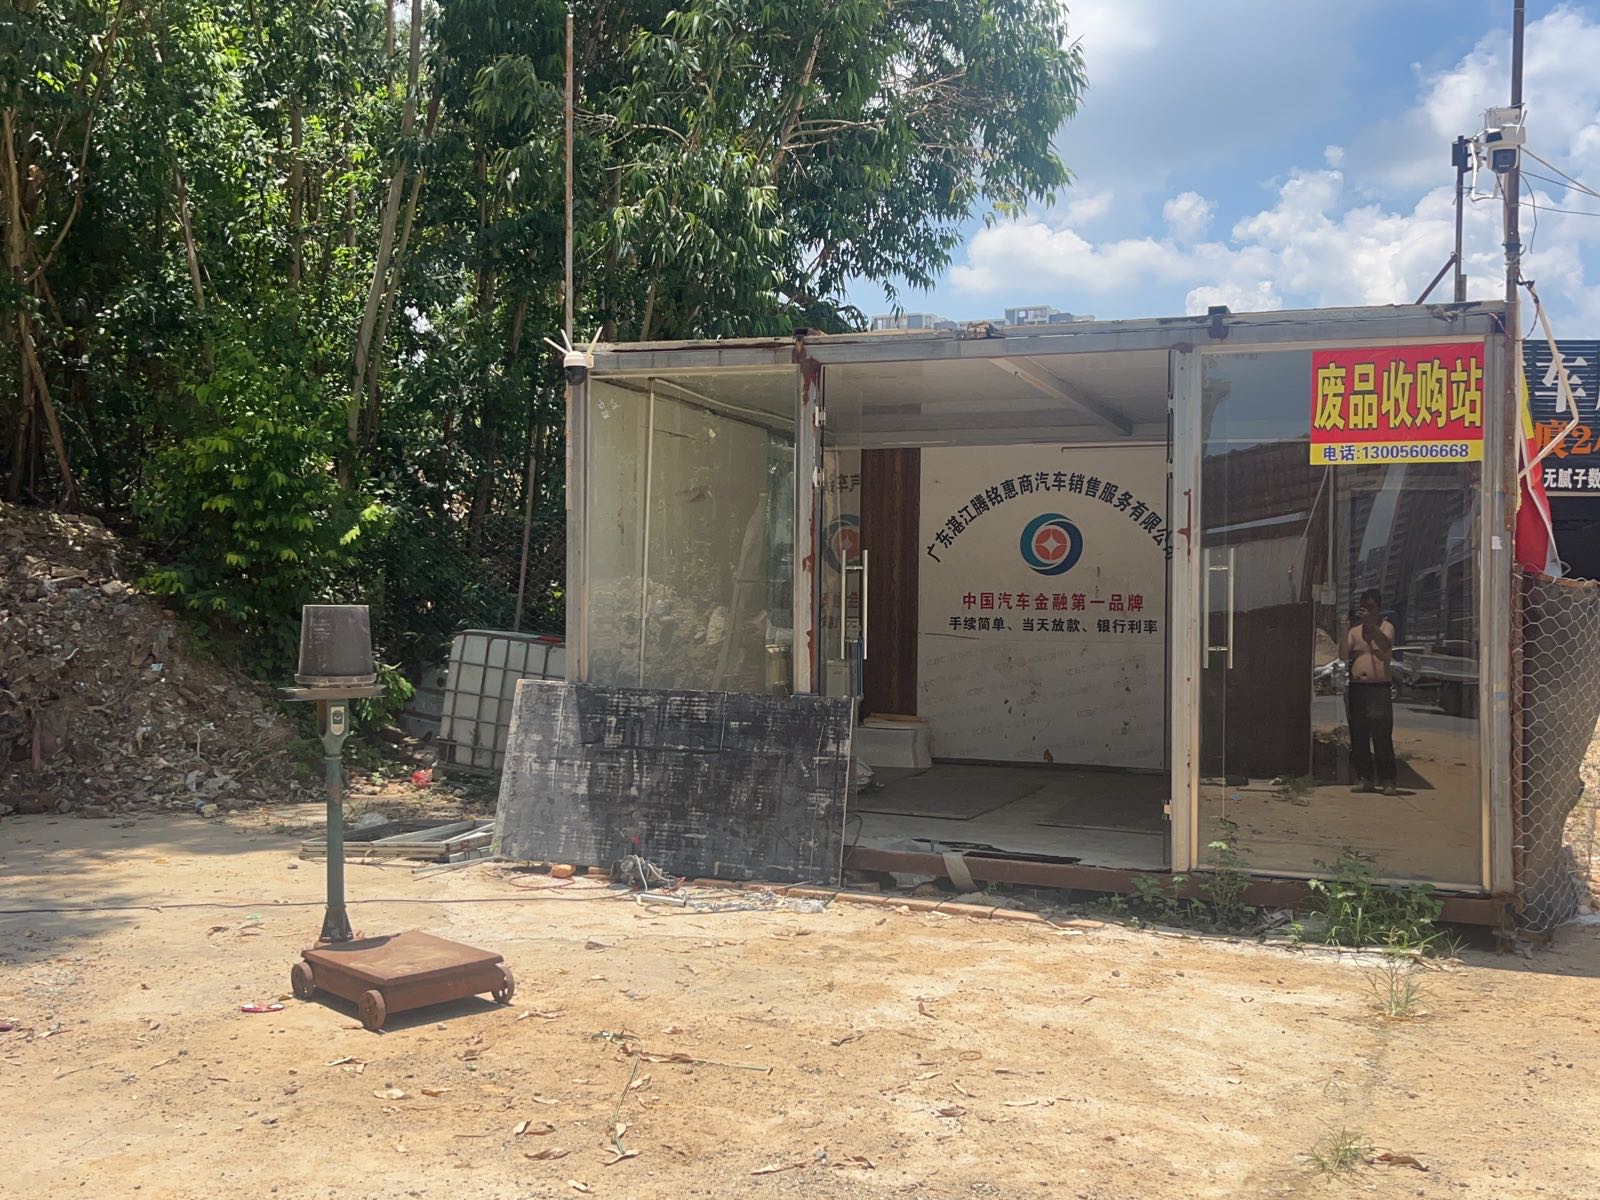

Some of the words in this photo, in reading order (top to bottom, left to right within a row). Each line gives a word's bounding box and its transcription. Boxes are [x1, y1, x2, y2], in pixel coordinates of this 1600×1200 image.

[1313, 357, 1483, 431] 废品收购站
[1323, 443, 1469, 461] 电话:13005606668
[962, 592, 1144, 612] 中国汽车金融第一品牌
[949, 616, 1158, 634] 手续简单、当天放款、银行利率
